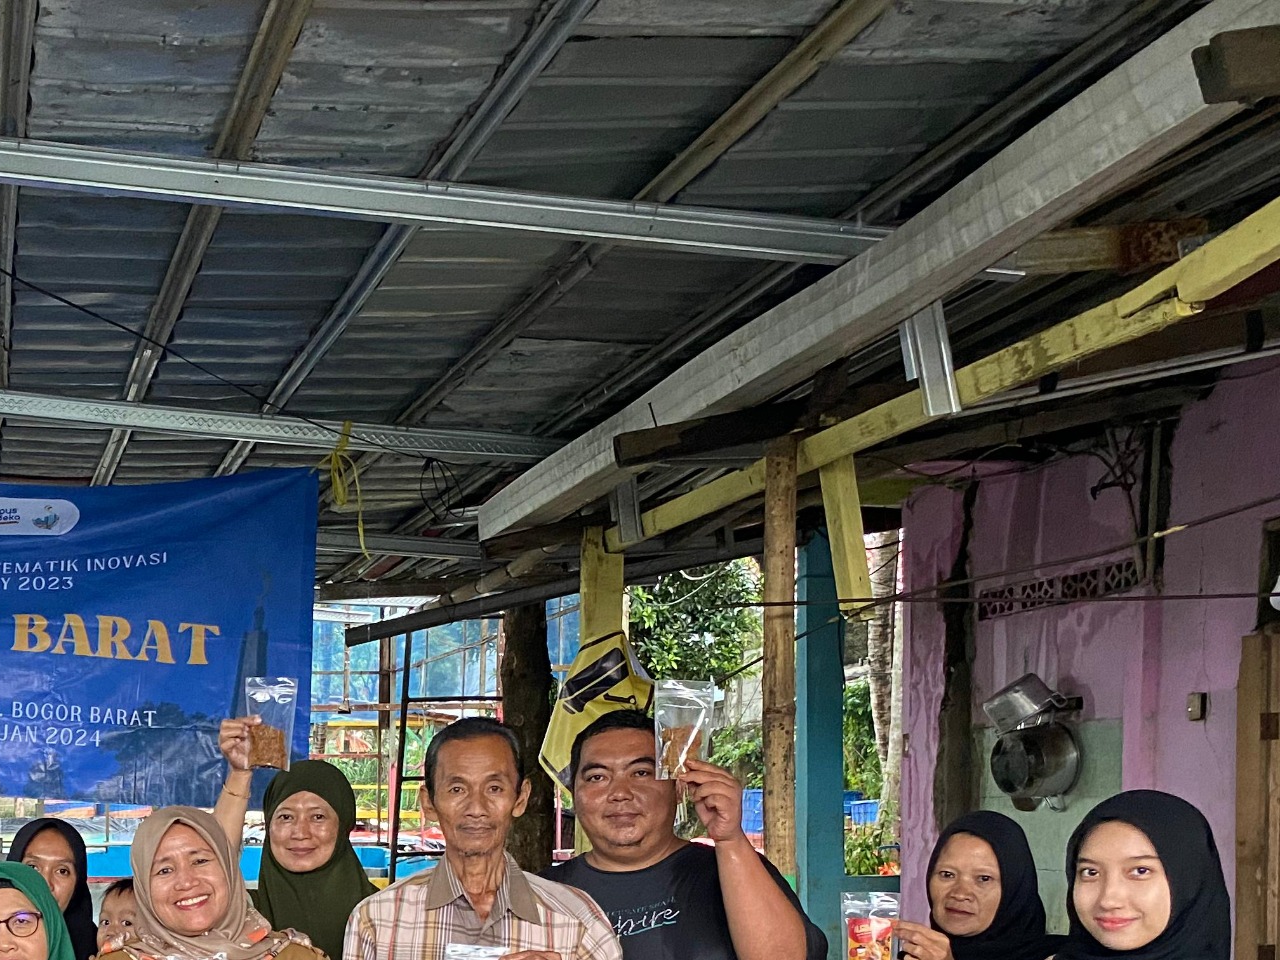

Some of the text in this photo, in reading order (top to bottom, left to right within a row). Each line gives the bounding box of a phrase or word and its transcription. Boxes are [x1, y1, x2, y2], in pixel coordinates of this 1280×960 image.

[86, 551, 167, 572] INOVASI
[18, 576, 74, 591] 2023
[11, 613, 221, 665] BARAT
[11, 702, 83, 722] BOGOR
[90, 706, 158, 727] BARAT
[45, 727, 102, 747] 2024
